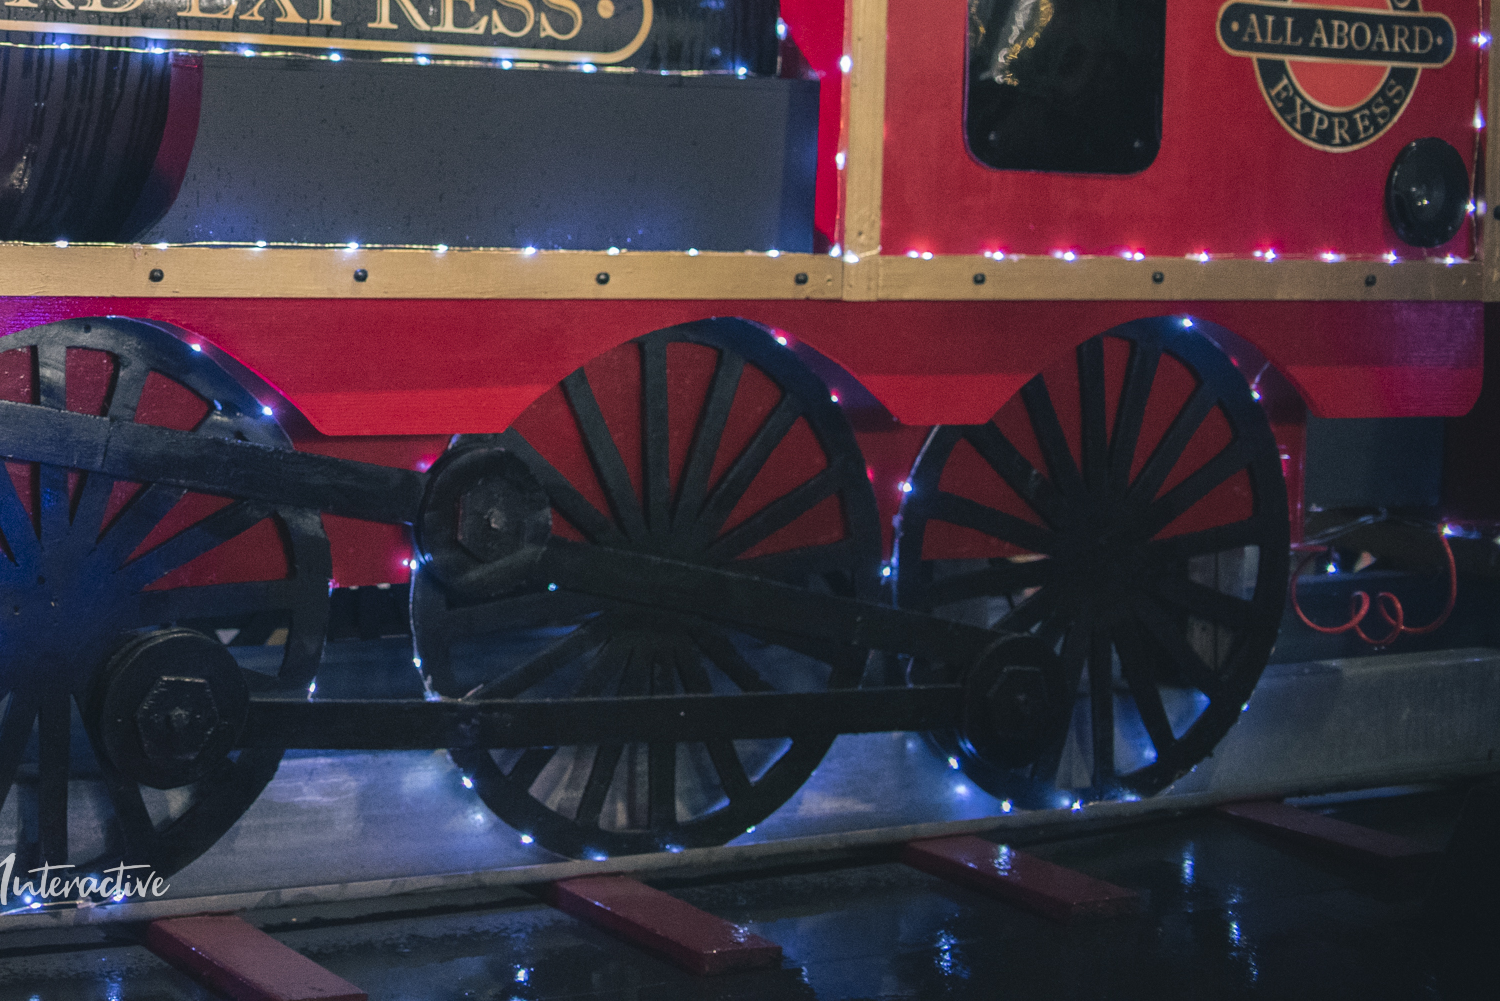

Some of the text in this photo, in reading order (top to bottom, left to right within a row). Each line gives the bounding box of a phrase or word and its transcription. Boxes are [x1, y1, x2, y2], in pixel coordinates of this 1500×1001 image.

[1242, 13, 1435, 55] ALL ABOARD
[1269, 74, 1406, 145] EXPRESS
